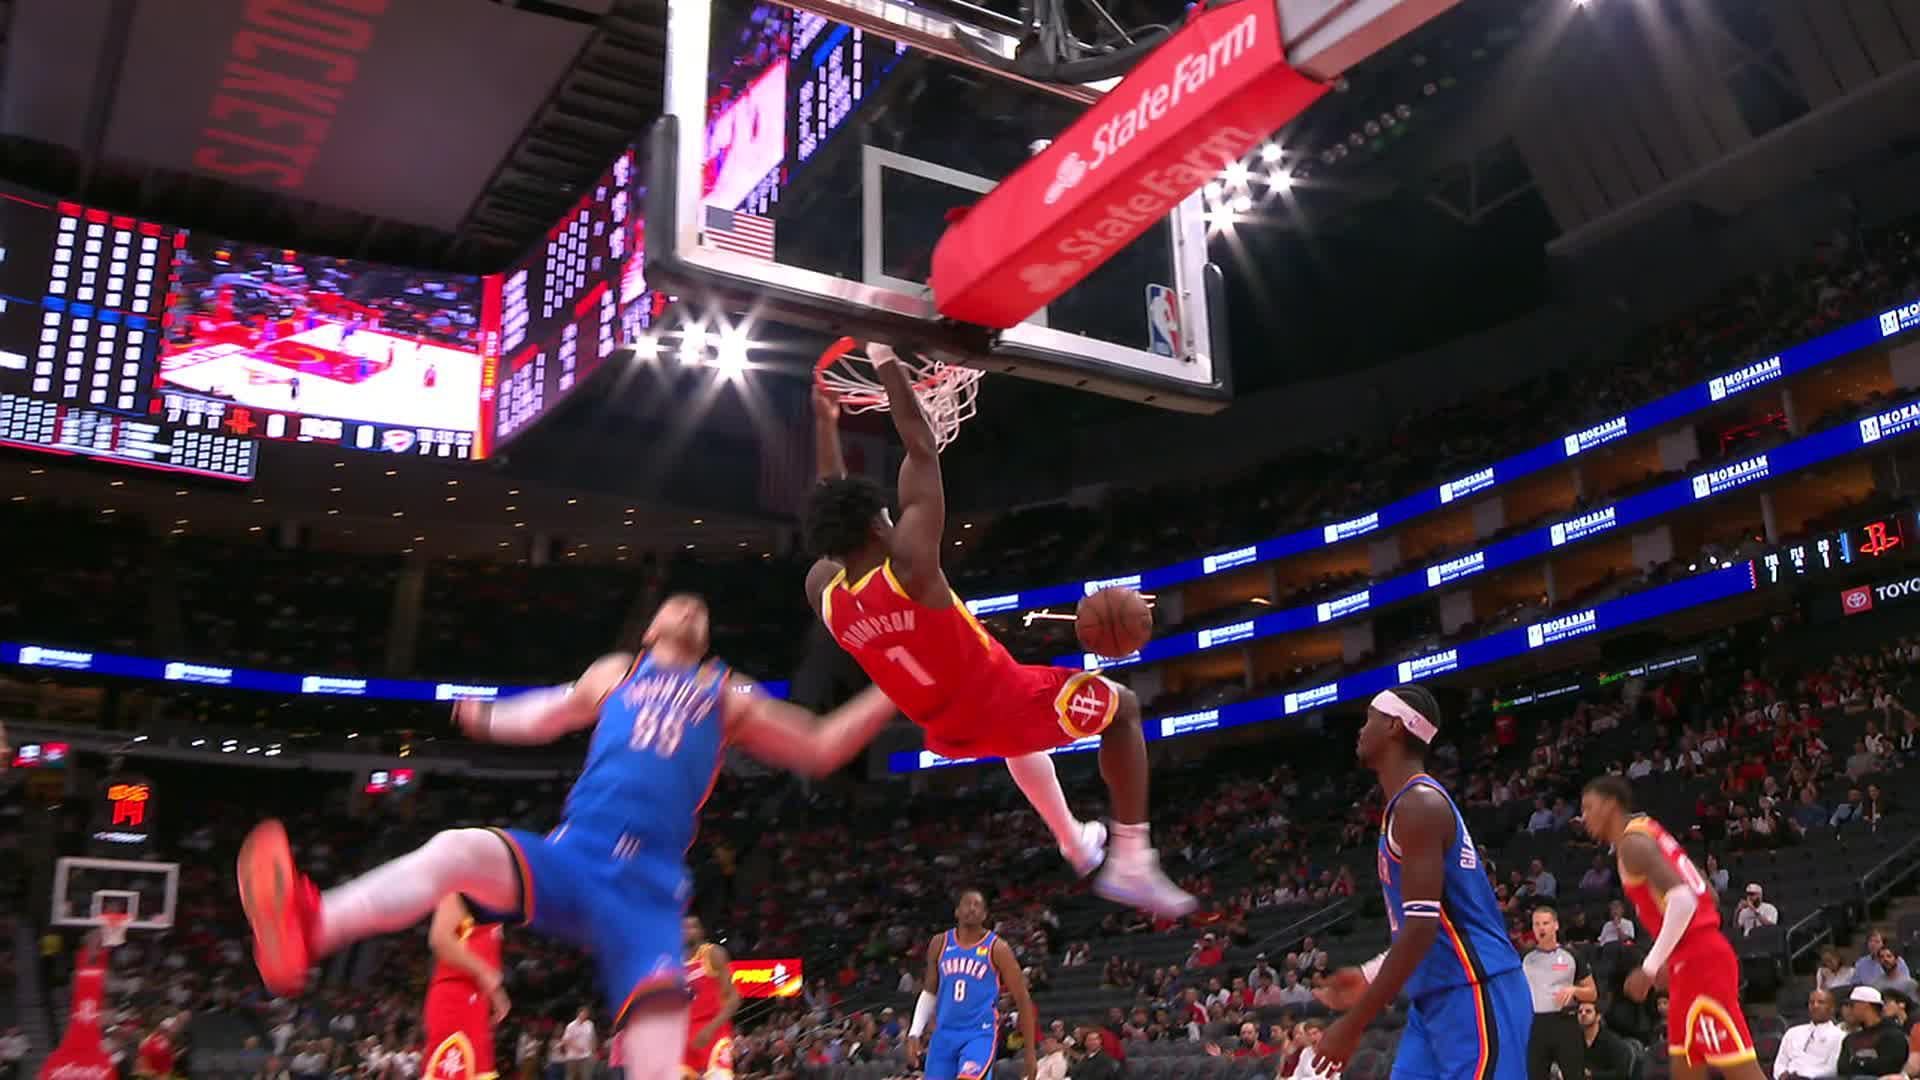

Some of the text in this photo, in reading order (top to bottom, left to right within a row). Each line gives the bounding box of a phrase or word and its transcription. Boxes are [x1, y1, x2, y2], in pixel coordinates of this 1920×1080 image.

[192, 0, 387, 188] OCKETS
[1898, 302, 1920, 320] MO
[1725, 356, 1781, 387] MOKARAM
[1880, 402, 1920, 427] MOKA
[1578, 416, 1627, 443] MOKARAM
[1709, 455, 1768, 484] MOKARAM
[1564, 507, 1615, 533] MOKARAM
[1543, 610, 1595, 636] MOKARAM
[884, 645, 936, 686] 1
[941, 957, 988, 981] THUNDER
[954, 979, 967, 1002] 8
